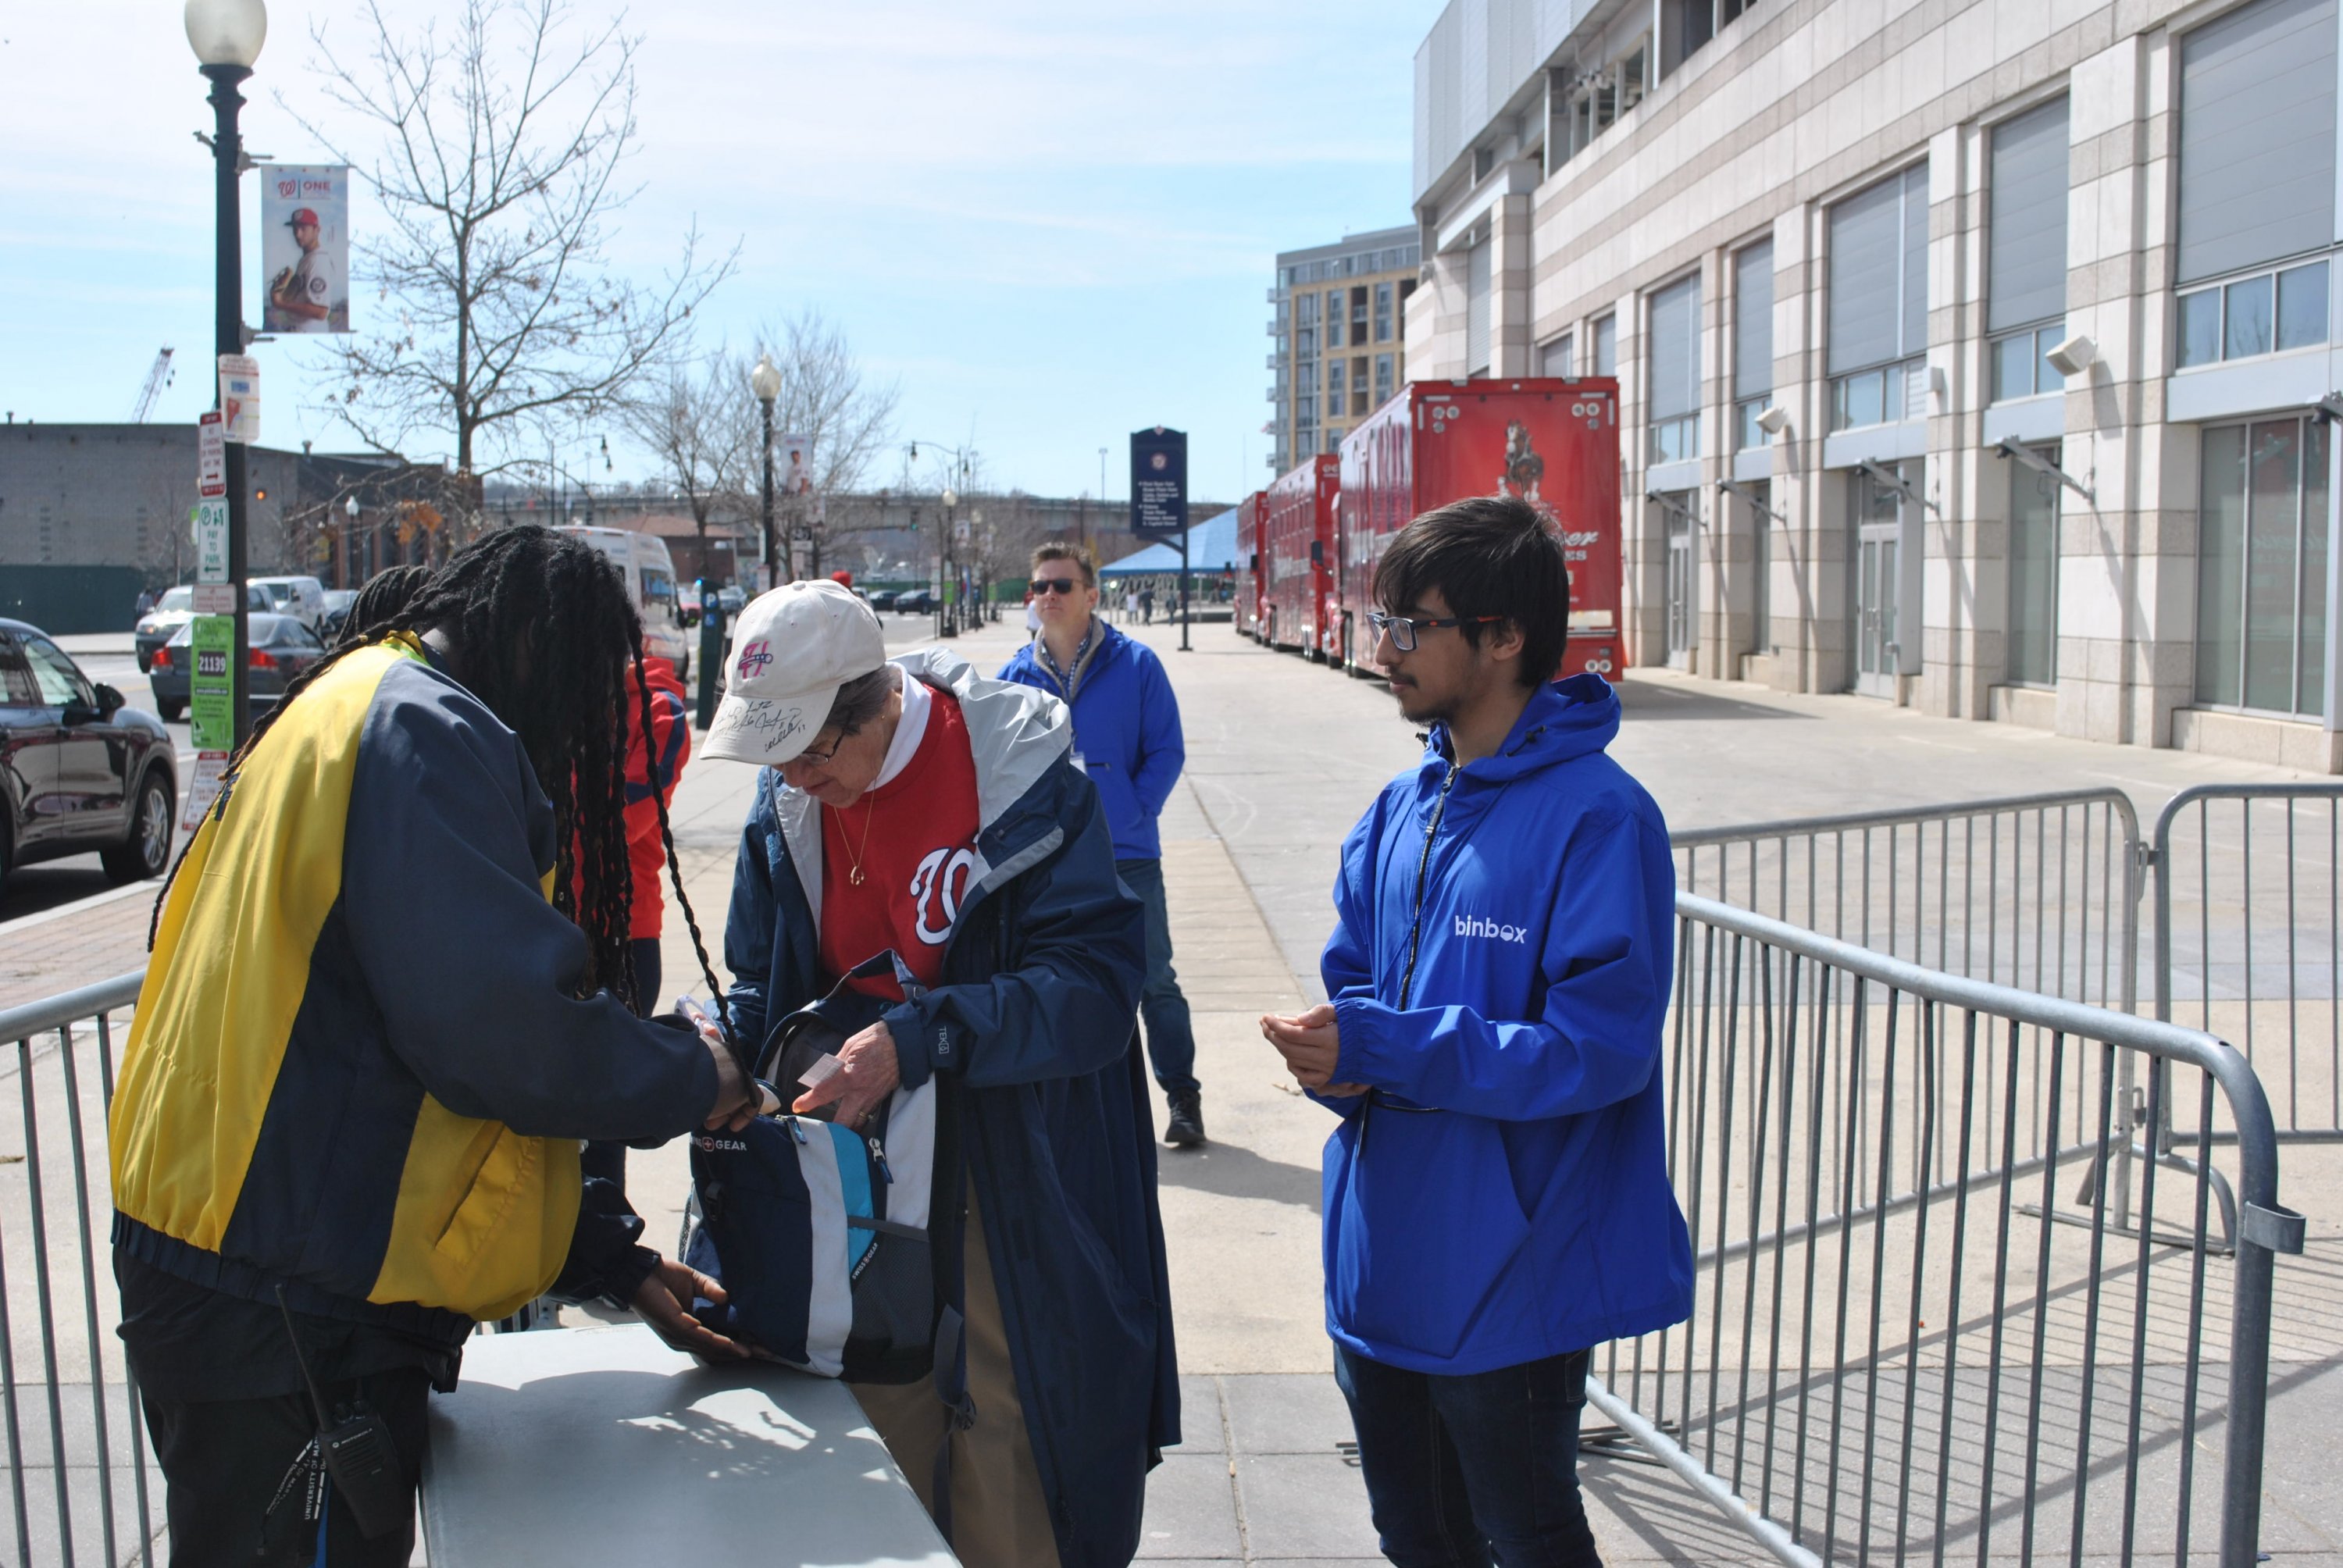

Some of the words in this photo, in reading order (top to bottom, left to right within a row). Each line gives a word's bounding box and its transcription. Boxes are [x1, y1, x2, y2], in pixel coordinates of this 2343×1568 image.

[303, 181, 331, 191] ONE
[205, 554, 220, 564] PARK
[198, 656, 226, 672] 21139
[1455, 914, 1528, 944] binbox
[715, 1140, 747, 1151] GEAR
[852, 1262, 866, 1280] SWISS
[868, 1242, 879, 1258] GEAR
[305, 1472, 316, 1520] UNIVERSITY
[311, 1459, 318, 1469] OF
